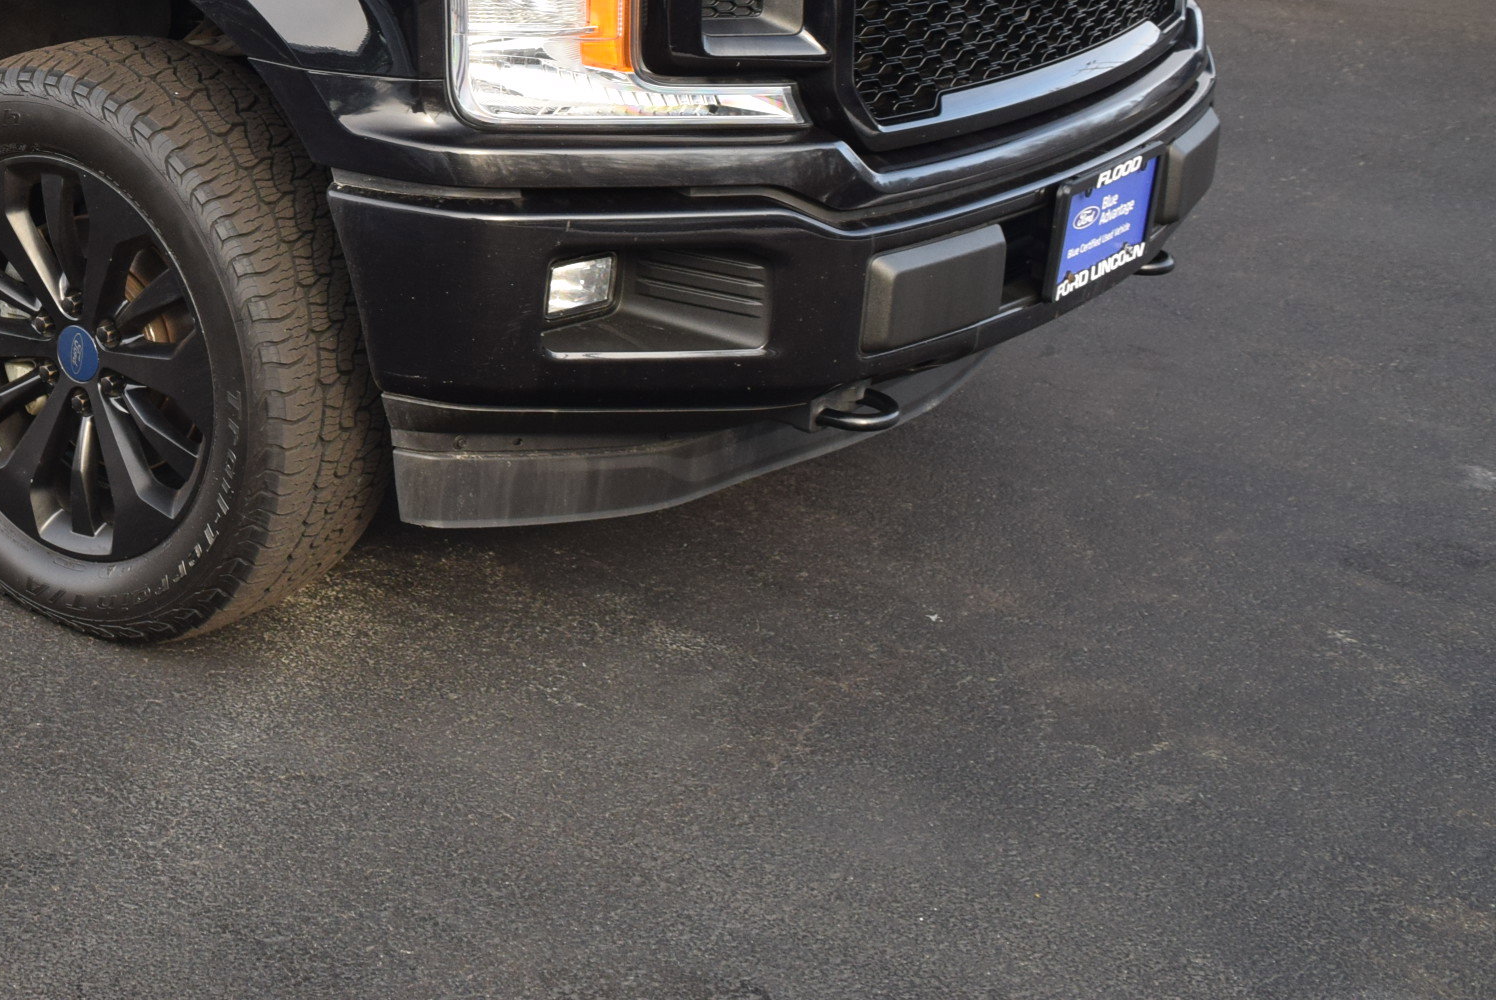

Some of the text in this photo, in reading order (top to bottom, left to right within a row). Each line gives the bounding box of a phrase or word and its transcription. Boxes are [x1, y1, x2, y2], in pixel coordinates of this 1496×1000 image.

[1096, 156, 1143, 188] FLOOD
[1098, 199, 1135, 226] Advantage
[1101, 194, 1119, 210] Blue
[1055, 241, 1146, 301] FORD LINCOLN
